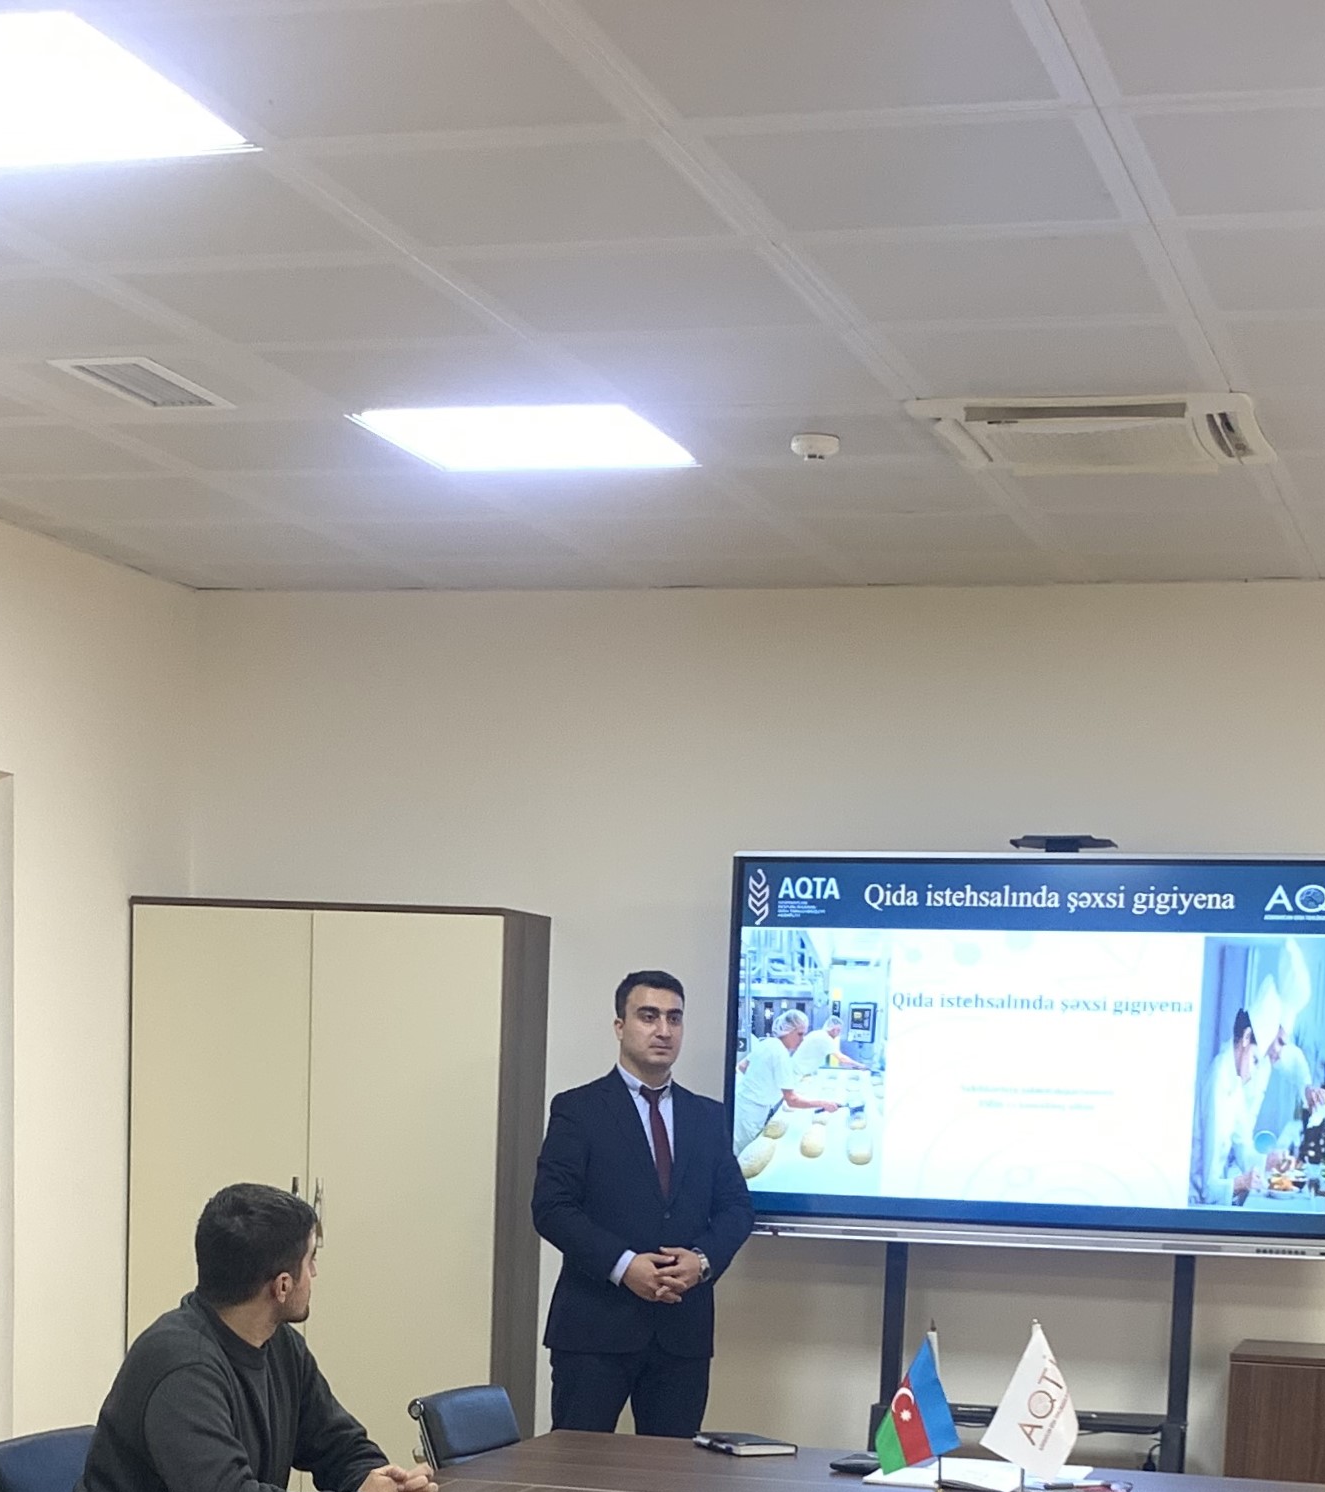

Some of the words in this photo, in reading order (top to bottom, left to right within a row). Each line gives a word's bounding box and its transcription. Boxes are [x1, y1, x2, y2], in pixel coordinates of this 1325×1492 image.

[778, 877, 841, 899] AQTA
[864, 884, 919, 911] Qida
[926, 884, 1060, 908] istehsalında
[1067, 885, 1125, 913] şəxsi
[1132, 886, 1235, 915] gigiyena
[892, 992, 933, 1011] Qida
